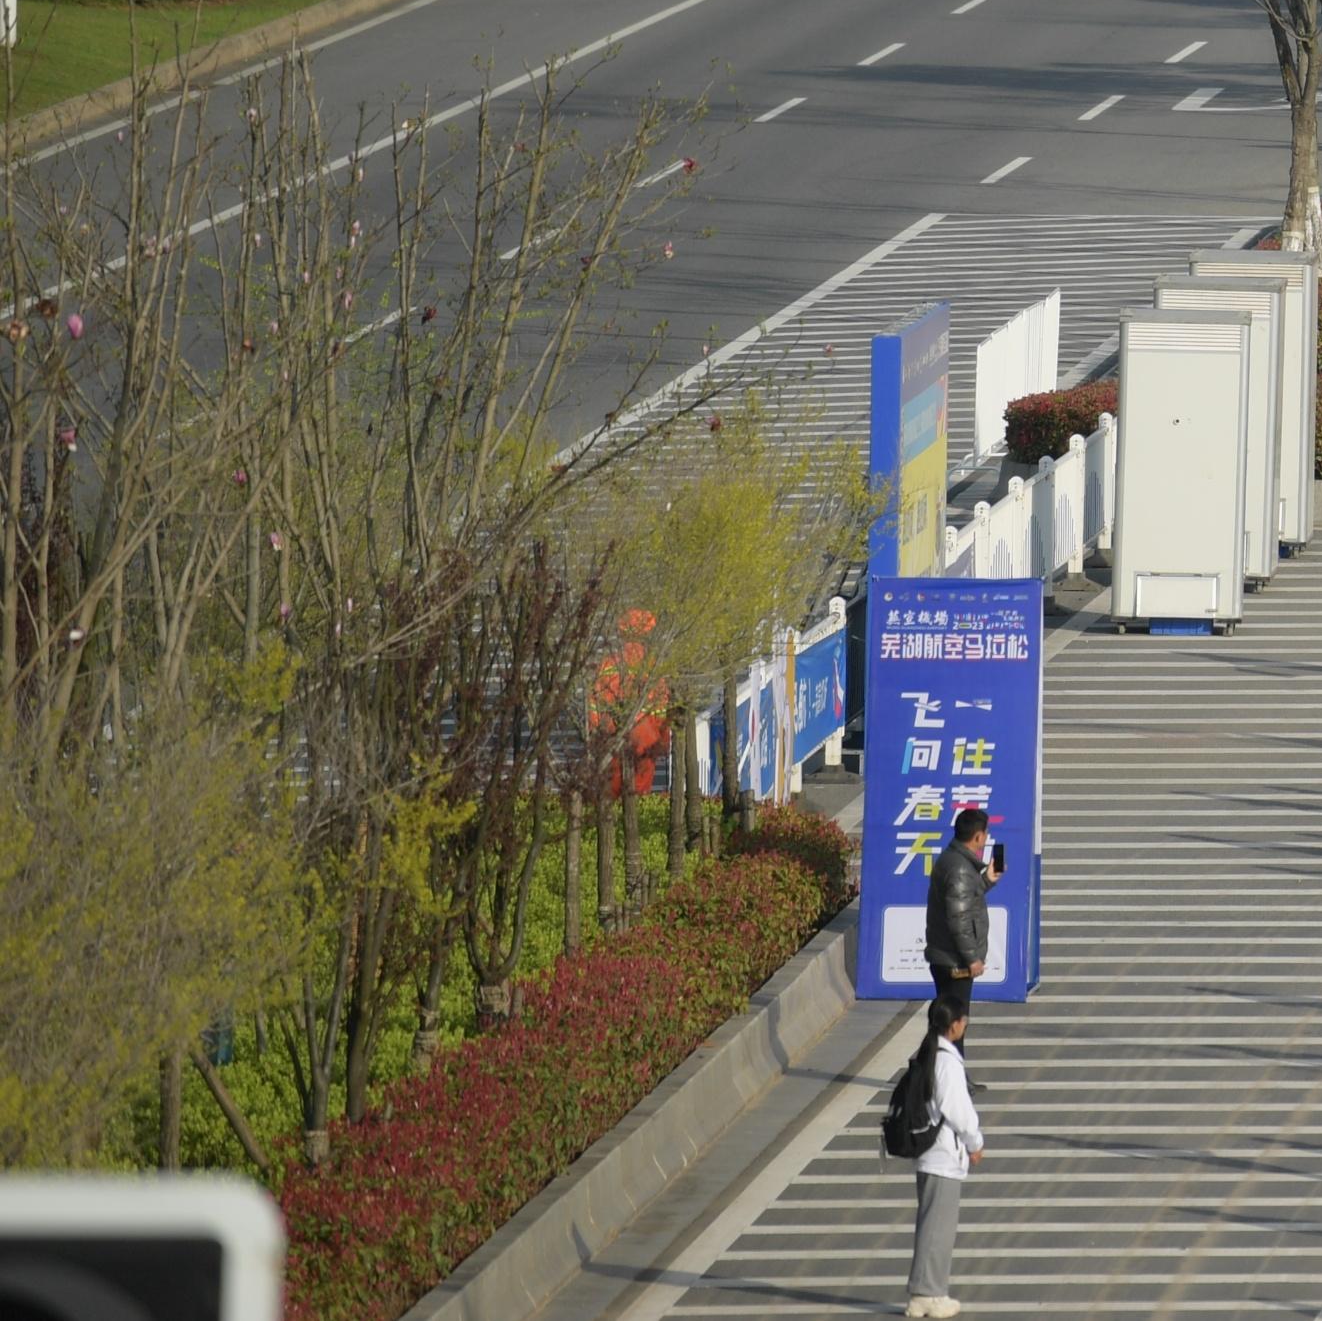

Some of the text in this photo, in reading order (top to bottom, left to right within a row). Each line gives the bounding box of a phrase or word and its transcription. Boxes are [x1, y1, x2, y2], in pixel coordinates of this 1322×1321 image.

[880, 633, 1029, 660] 芜湖航空马拉松
[893, 692, 946, 876] 飞向春天
